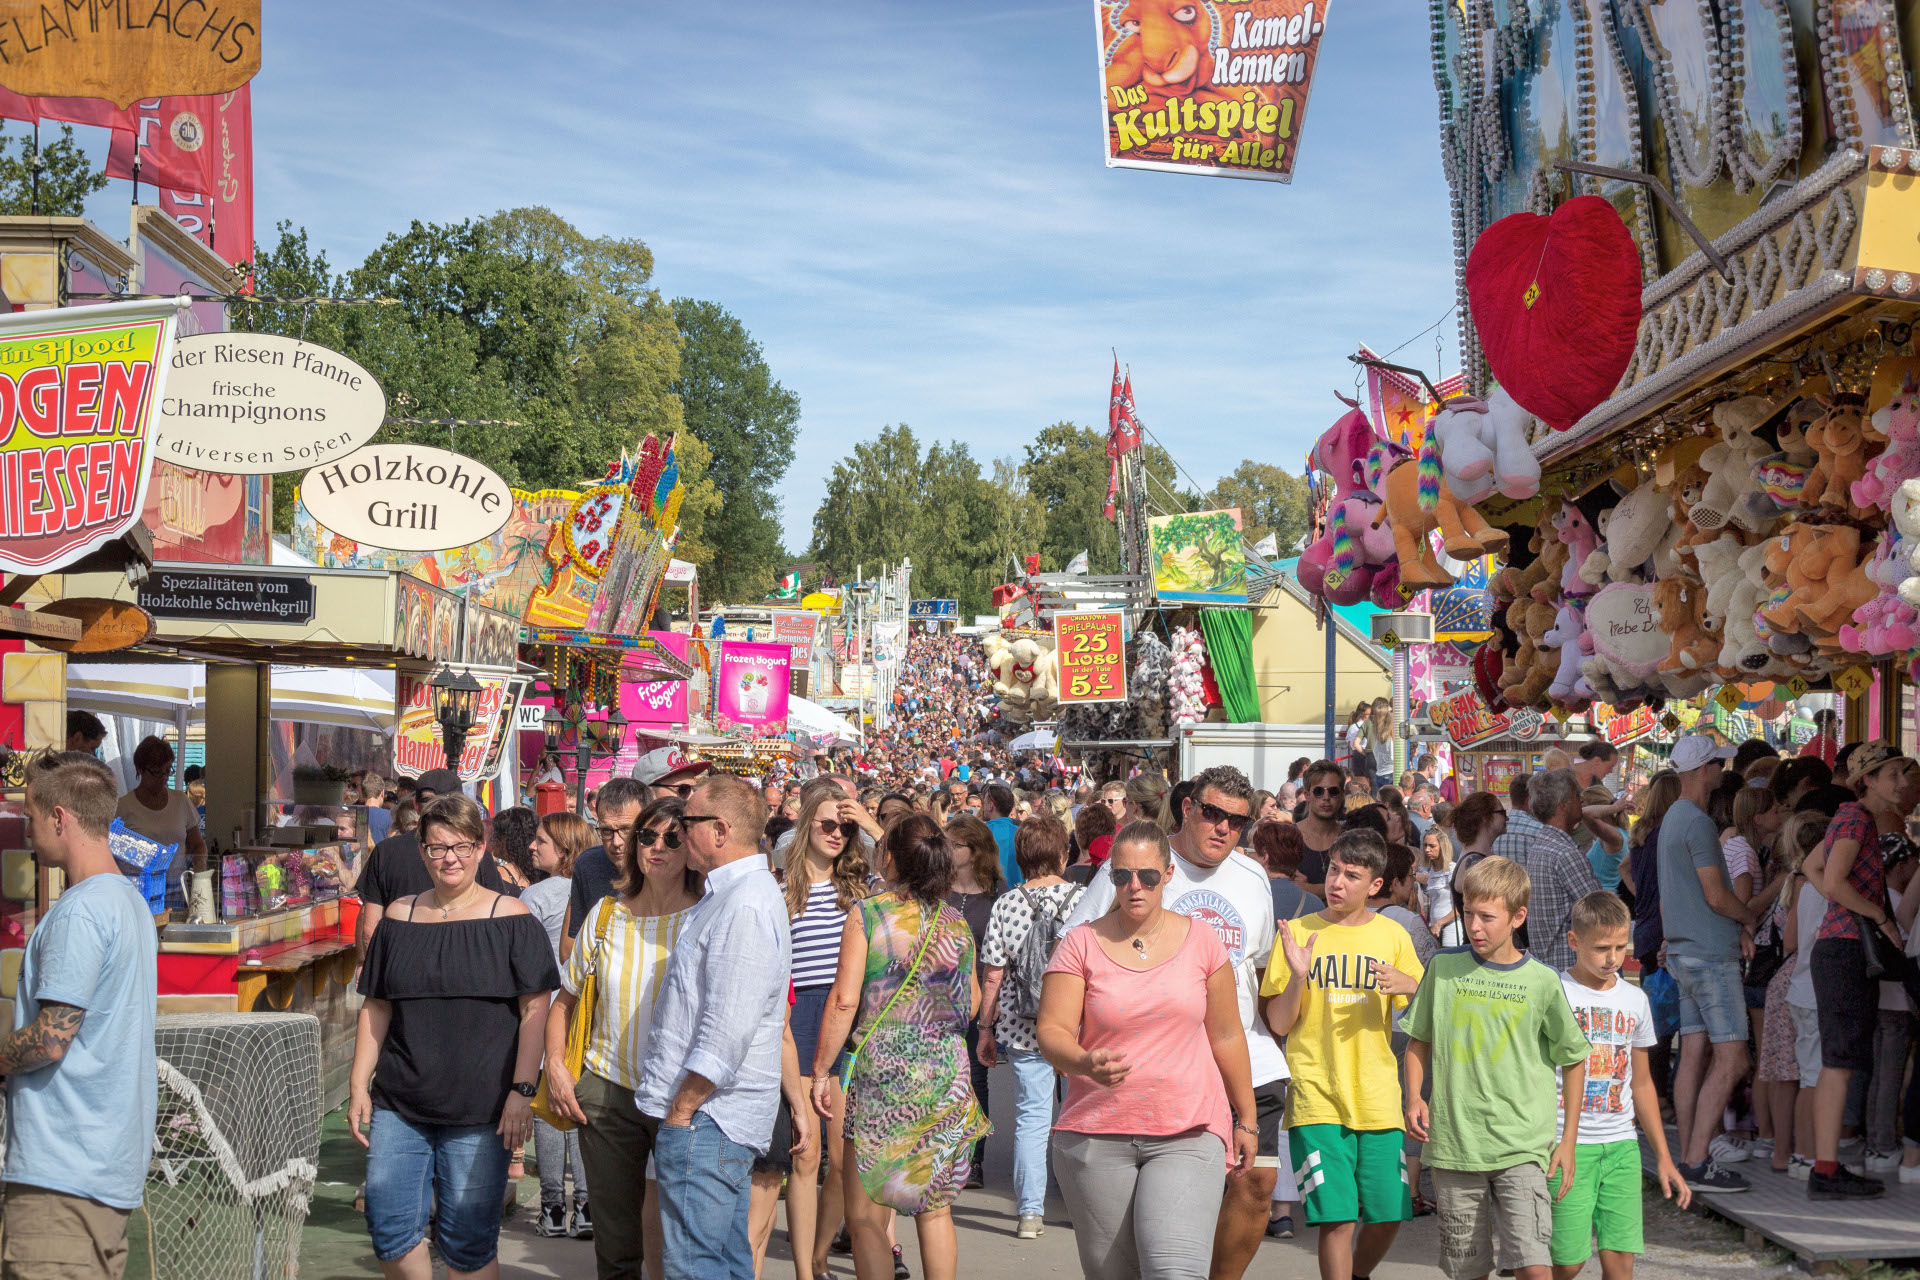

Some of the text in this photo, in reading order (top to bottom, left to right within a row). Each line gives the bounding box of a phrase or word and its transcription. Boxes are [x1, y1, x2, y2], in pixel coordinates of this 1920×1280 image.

[1231, 2, 1323, 50] Kamel-
[1211, 47, 1306, 85] Rennen
[1110, 84, 1148, 108] Das
[1112, 91, 1295, 151] Kultspiel
[1171, 136, 1285, 169] für Alle!
[33, 331, 135, 365] Hood
[171, 344, 362, 392] der Riesen Pfanne
[212, 380, 276, 398] frische
[161, 398, 327, 425] Champignons
[171, 439, 274, 463] diversen
[283, 431, 352, 462] Soßen
[0, 437, 144, 540] IESSEN
[318, 455, 501, 514] Holzkohle
[367, 500, 438, 531] Grill
[161, 575, 289, 593] Spezialitäten vom
[666, 566, 687, 578] ogurt
[1327, 572, 1342, 581] 3x
[140, 593, 309, 617] Holzkohle Schwenkgrill
[916, 601, 932, 614] Eis
[1061, 622, 1118, 635] SPIELPALAST
[1383, 633, 1397, 643] 5x
[1609, 621, 1639, 636] liebe
[1073, 631, 1109, 653] 25
[724, 653, 756, 666] Frozen
[756, 655, 788, 671] Yogurt
[1062, 650, 1119, 667] Lose
[1791, 679, 1804, 691] 1x
[1429, 690, 1478, 725] BREAK
[1723, 692, 1736, 703] 1x
[519, 707, 541, 723] WC
[1175, 892, 1239, 925] RANSATLANTIC
[1307, 953, 1384, 990] MALIB
[1487, 980, 1517, 990] YONKERS
